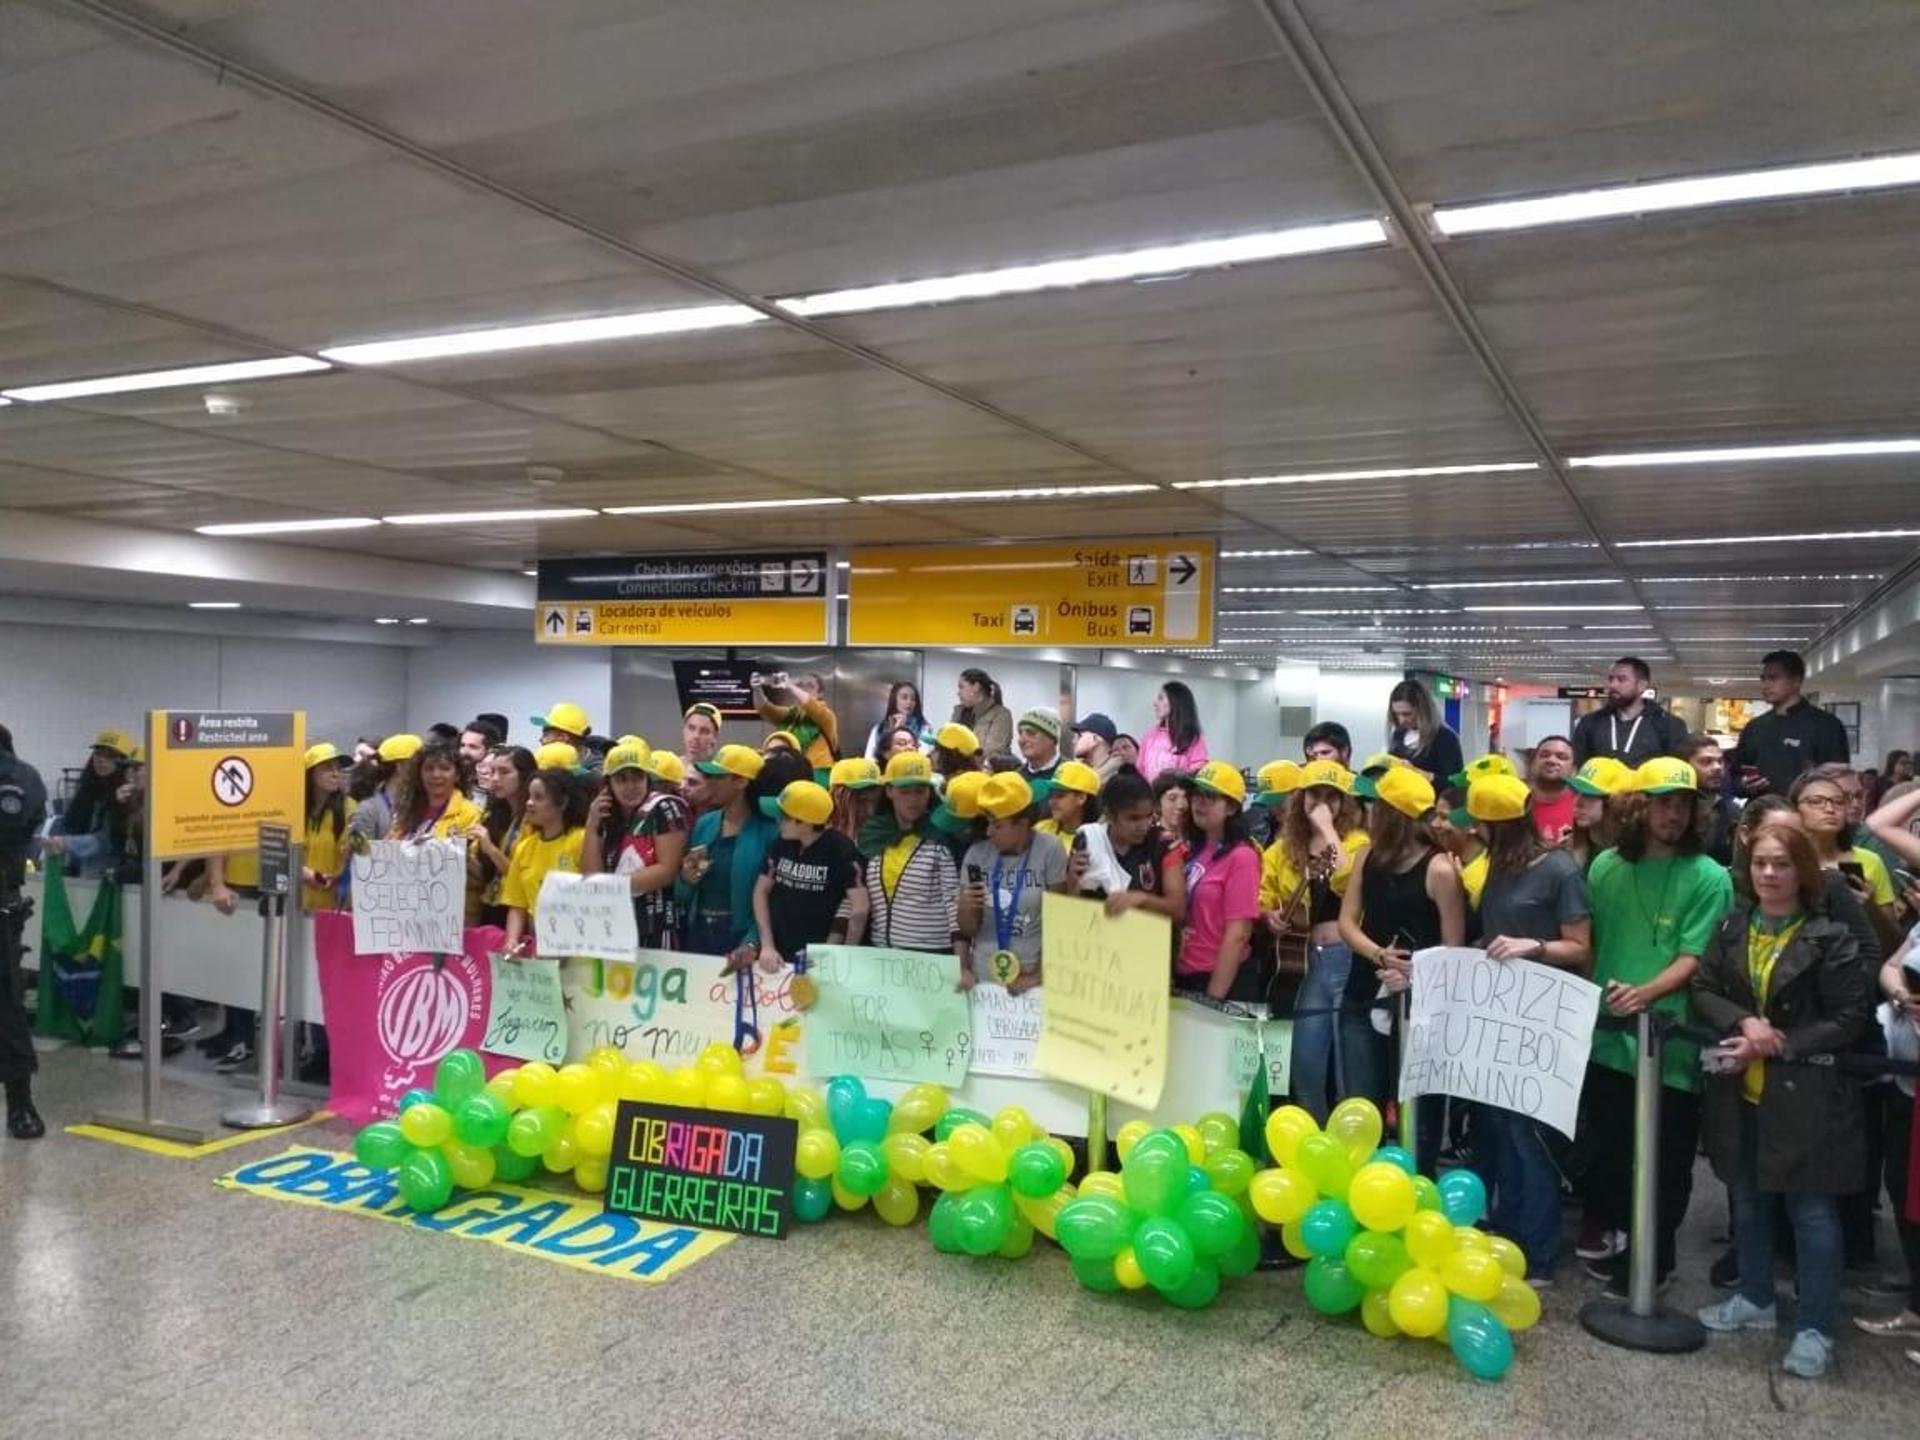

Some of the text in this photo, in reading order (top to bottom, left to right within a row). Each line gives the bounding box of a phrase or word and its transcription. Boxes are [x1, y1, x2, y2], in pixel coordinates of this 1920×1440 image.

[617, 577, 757, 594] Connections check-in
[1087, 571, 1120, 588] Exit
[598, 604, 732, 619] Locadora de veículos
[1057, 597, 1118, 618] Ônibus
[599, 621, 661, 635] Car rental
[972, 613, 1004, 627] Taxi
[1087, 621, 1118, 637] Bus
[198, 731, 247, 743] Restricted
[850, 993, 889, 1028] POR
[1416, 959, 1589, 1041] VALORIZE
[385, 971, 462, 1060] UBM
[828, 1028, 914, 1072] TODAS
[1427, 1012, 1575, 1089] FUTEBOL
[1404, 1058, 1543, 1116] FEMININO
[234, 1152, 703, 1278] OBRGADA
